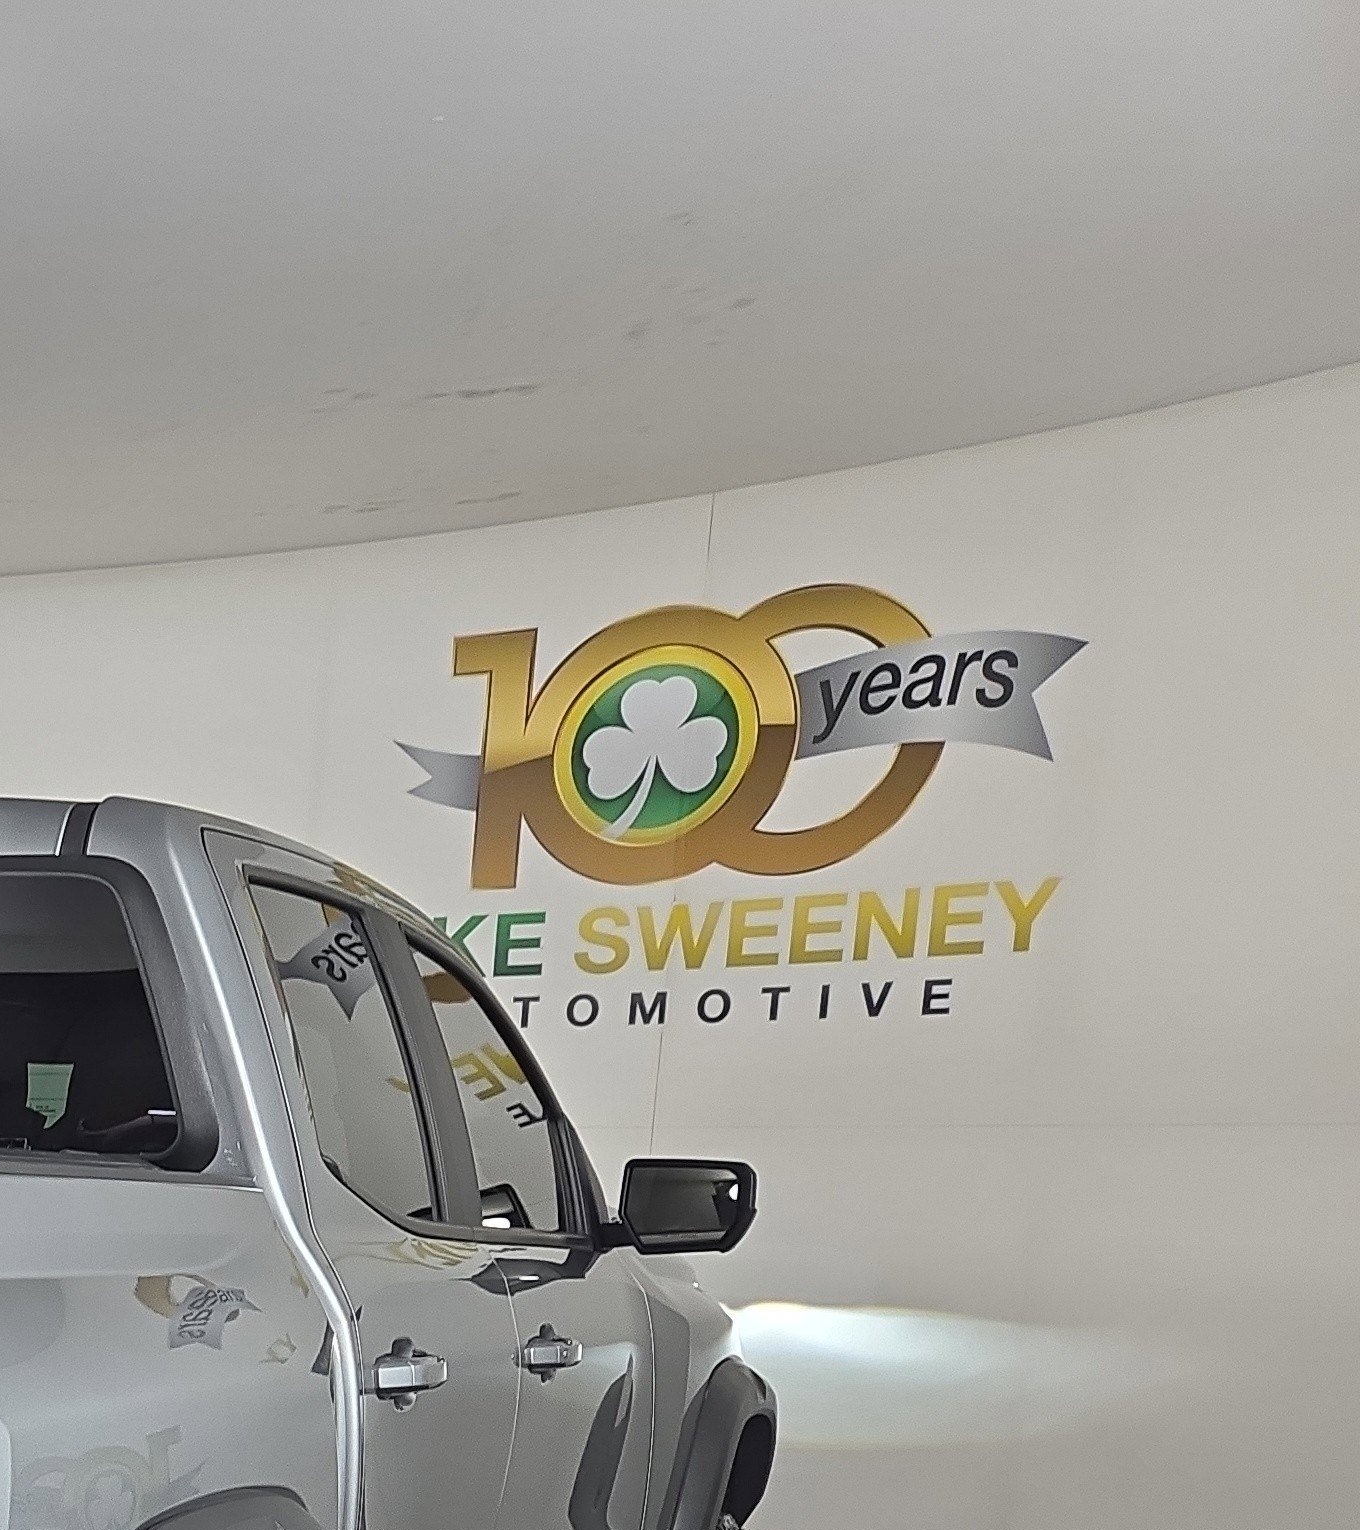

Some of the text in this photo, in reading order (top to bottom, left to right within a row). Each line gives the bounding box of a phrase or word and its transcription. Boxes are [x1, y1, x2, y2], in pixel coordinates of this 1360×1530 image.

[452, 582, 1021, 890] 100 years
[433, 876, 1063, 978] KE SWEENEY
[511, 977, 954, 1029] TOMOTIVE
